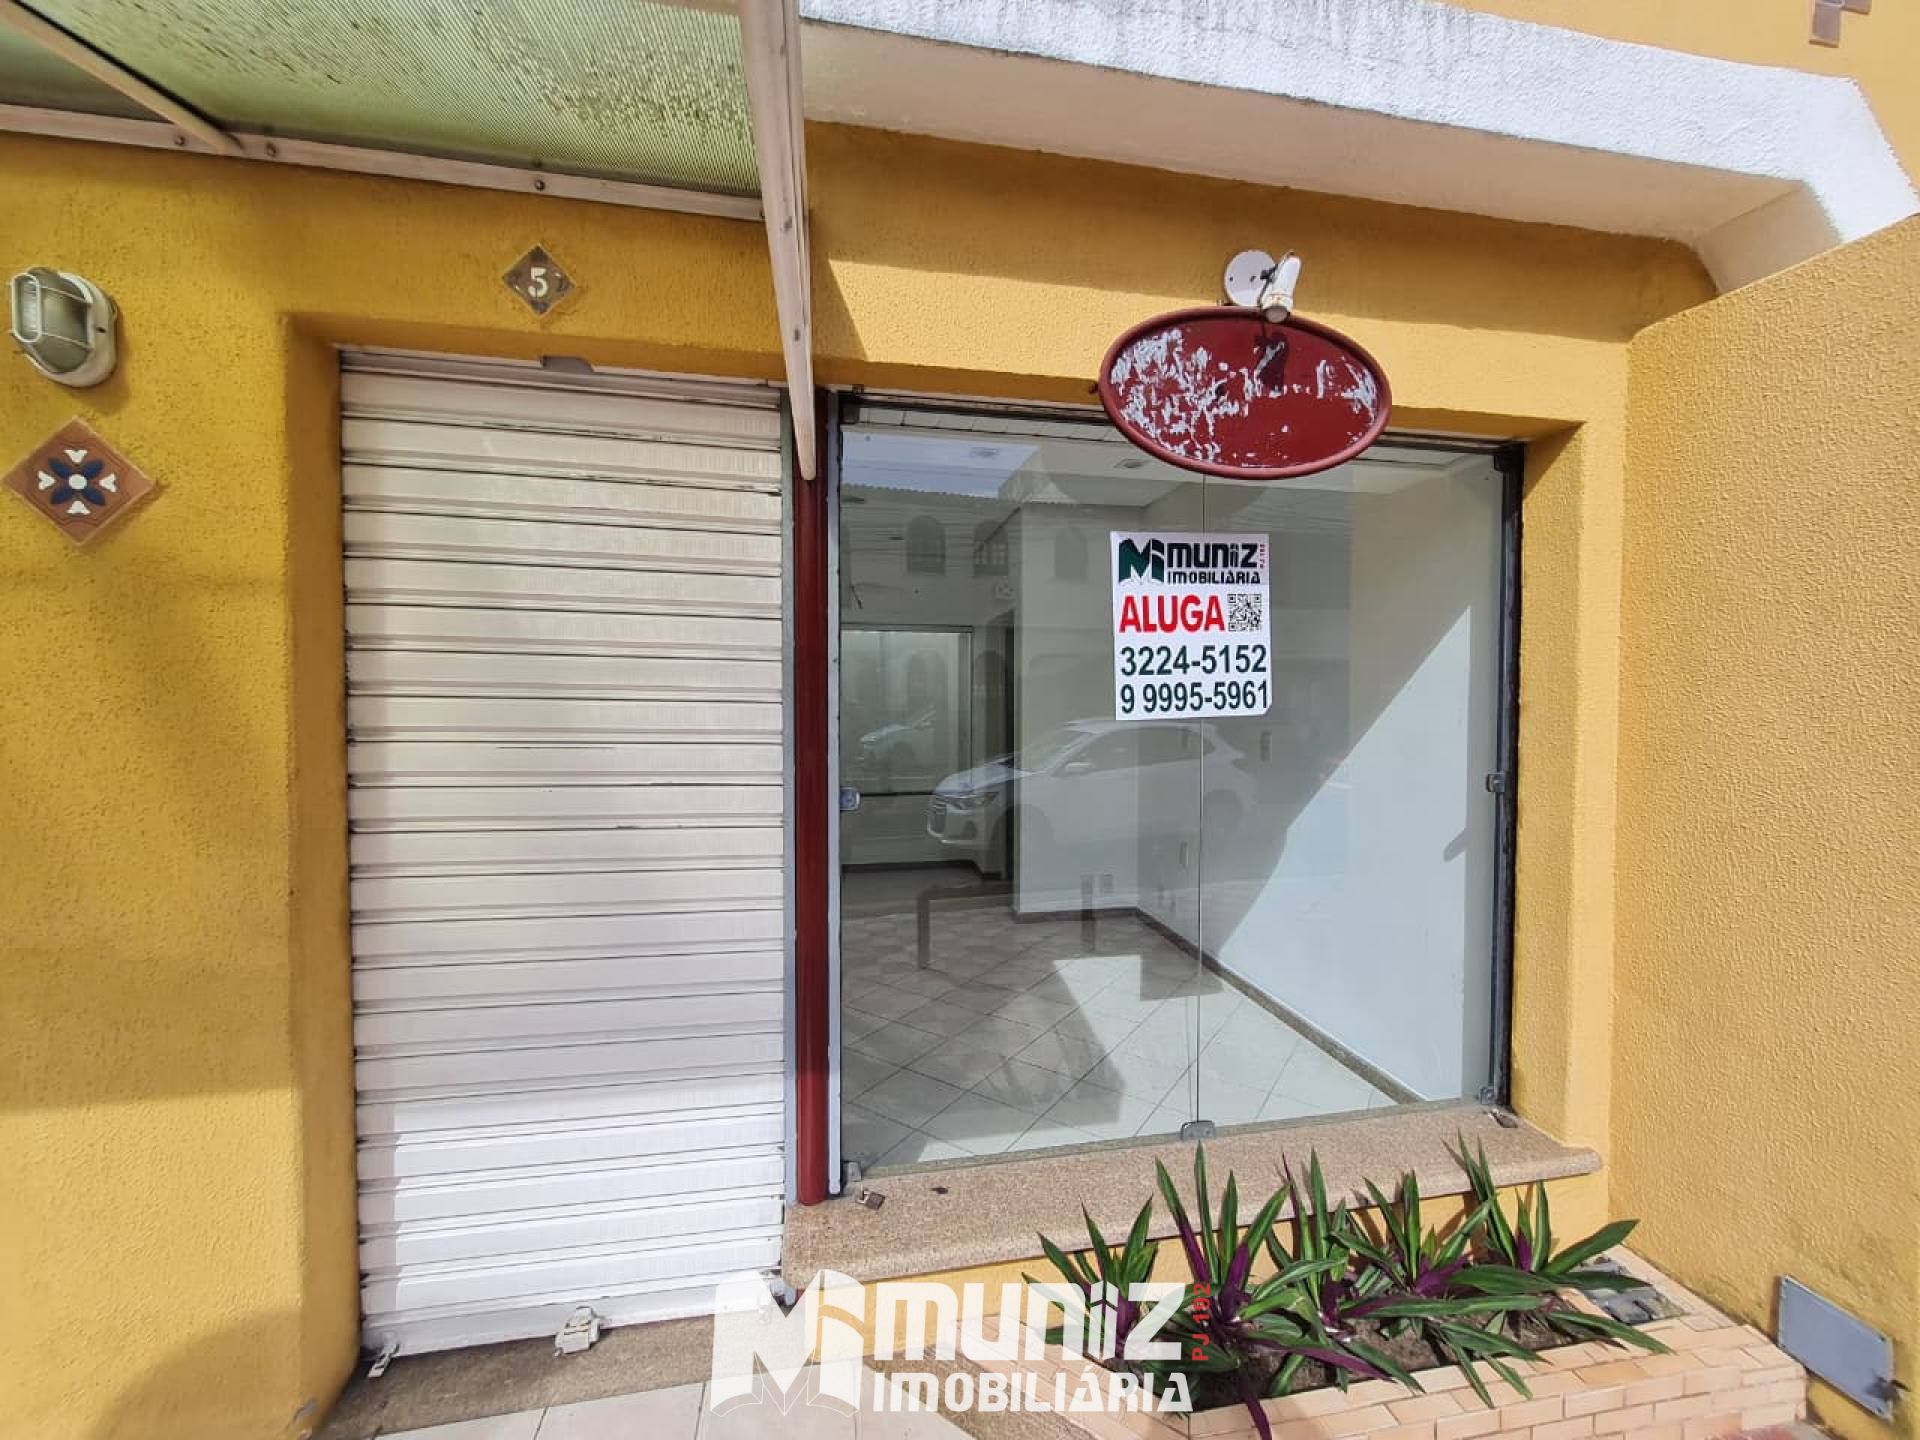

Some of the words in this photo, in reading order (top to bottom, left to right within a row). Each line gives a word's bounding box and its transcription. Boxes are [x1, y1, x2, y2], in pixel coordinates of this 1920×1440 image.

[527, 266, 548, 298] 5
[1119, 594, 1225, 633] ALUGA
[1121, 644, 1267, 676] 3224-5152
[1120, 684, 1135, 714] 9
[1142, 680, 1268, 712] 9995-5961
